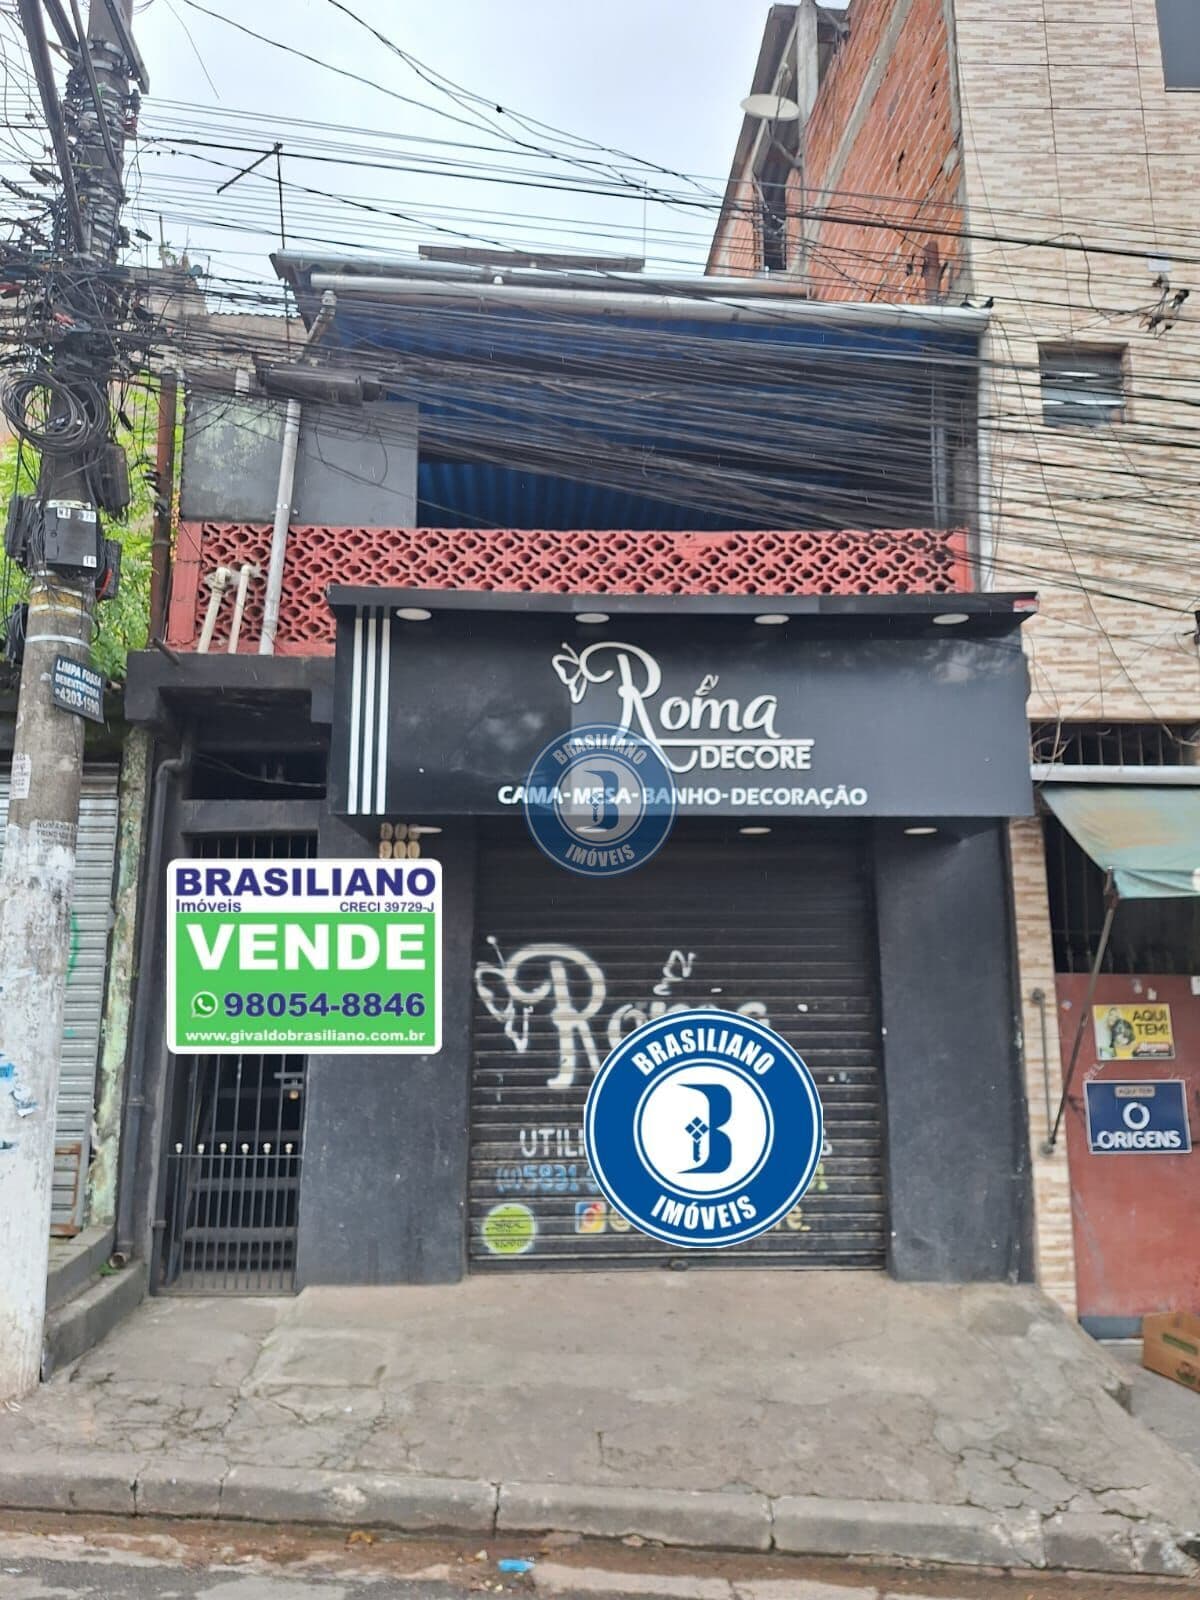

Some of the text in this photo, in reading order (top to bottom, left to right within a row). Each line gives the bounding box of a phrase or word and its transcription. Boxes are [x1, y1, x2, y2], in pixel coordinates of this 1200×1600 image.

[56, 658, 81, 679] LIMPA
[578, 641, 783, 772] Roma
[699, 744, 812, 770] DECORE
[1132, 1009, 1168, 1022] AQUI
[1095, 1130, 1182, 1149] ORIGENS
